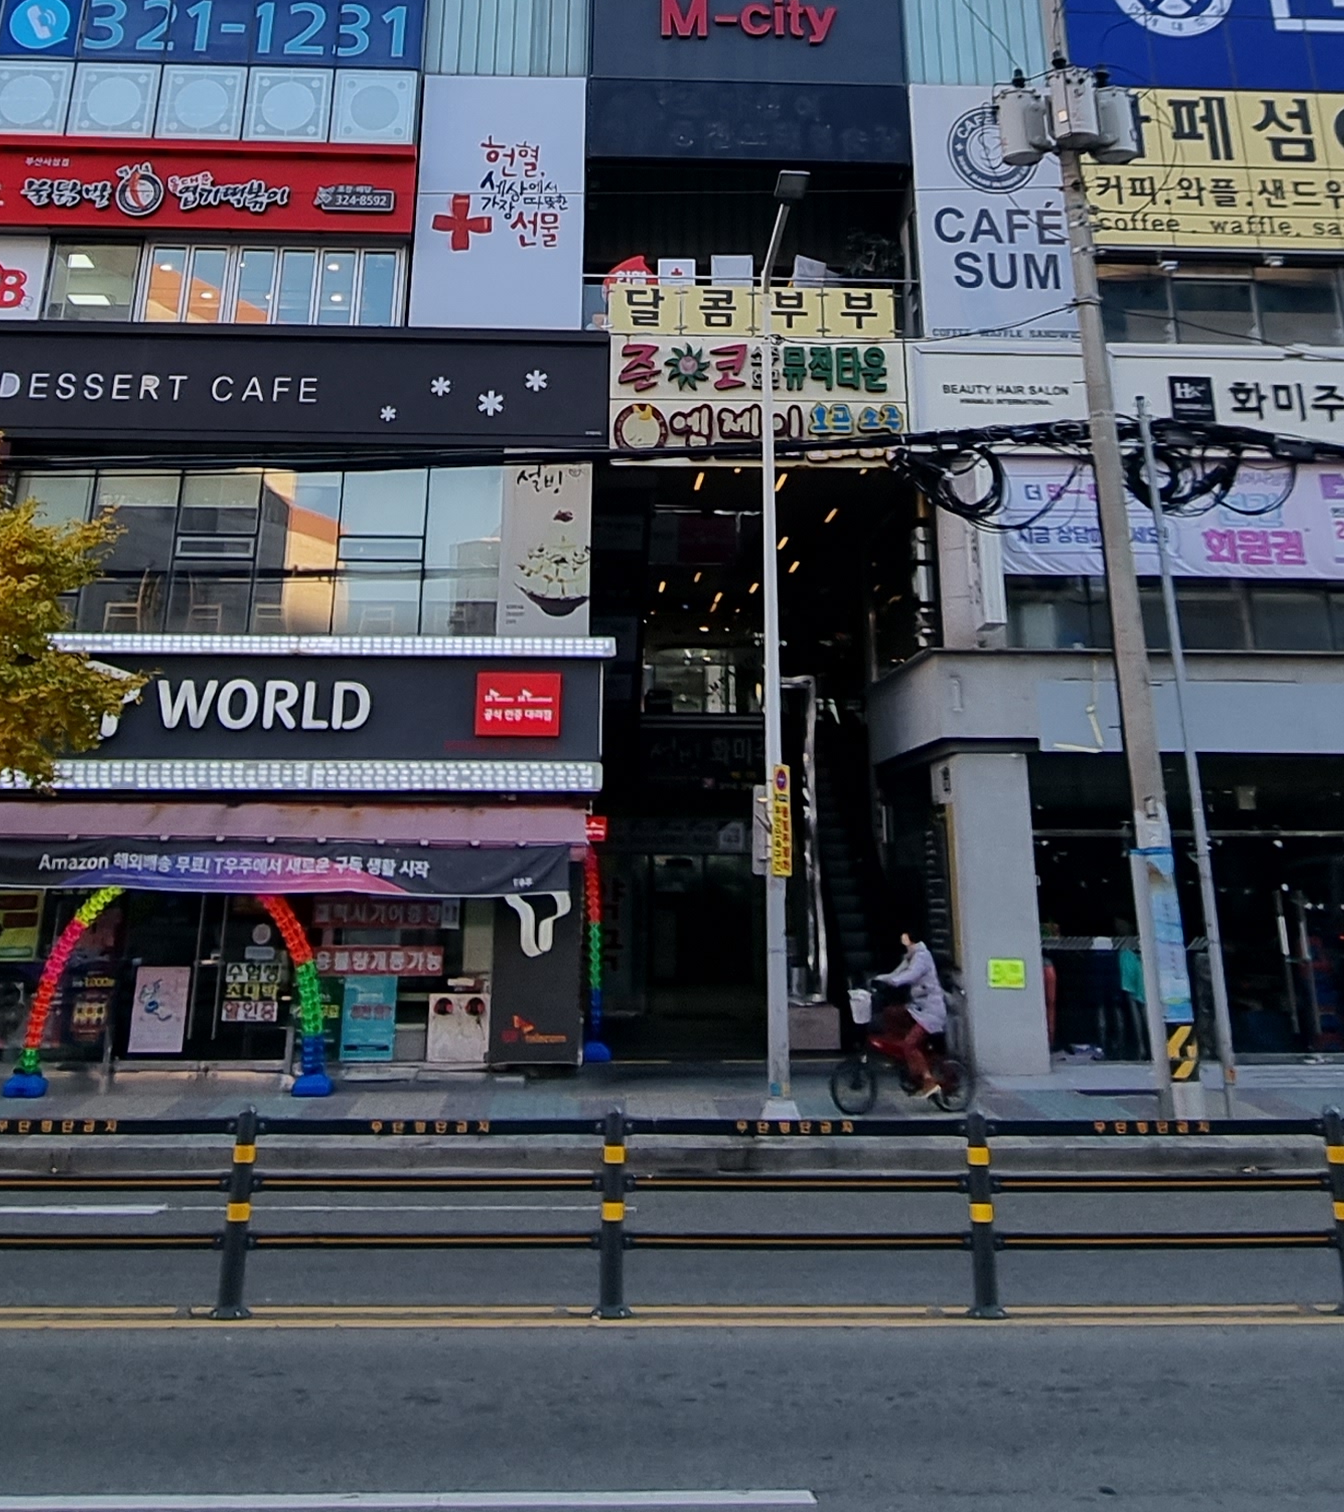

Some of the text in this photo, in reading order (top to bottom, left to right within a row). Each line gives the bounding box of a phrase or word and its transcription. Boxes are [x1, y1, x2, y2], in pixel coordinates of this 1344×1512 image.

[510, 212, 560, 249] 선물
[953, 250, 1062, 291] SUM
[624, 288, 880, 329] 달콤부부
[782, 345, 888, 392] 뮤직타운
[211, 374, 320, 404] CAFE
[941, 384, 1069, 397] BEAUTY HAIR SALON
[516, 463, 565, 492] 설빙
[157, 676, 371, 733] WORLD
[38, 853, 110, 873] Amazon
[399, 859, 429, 878] 시작
